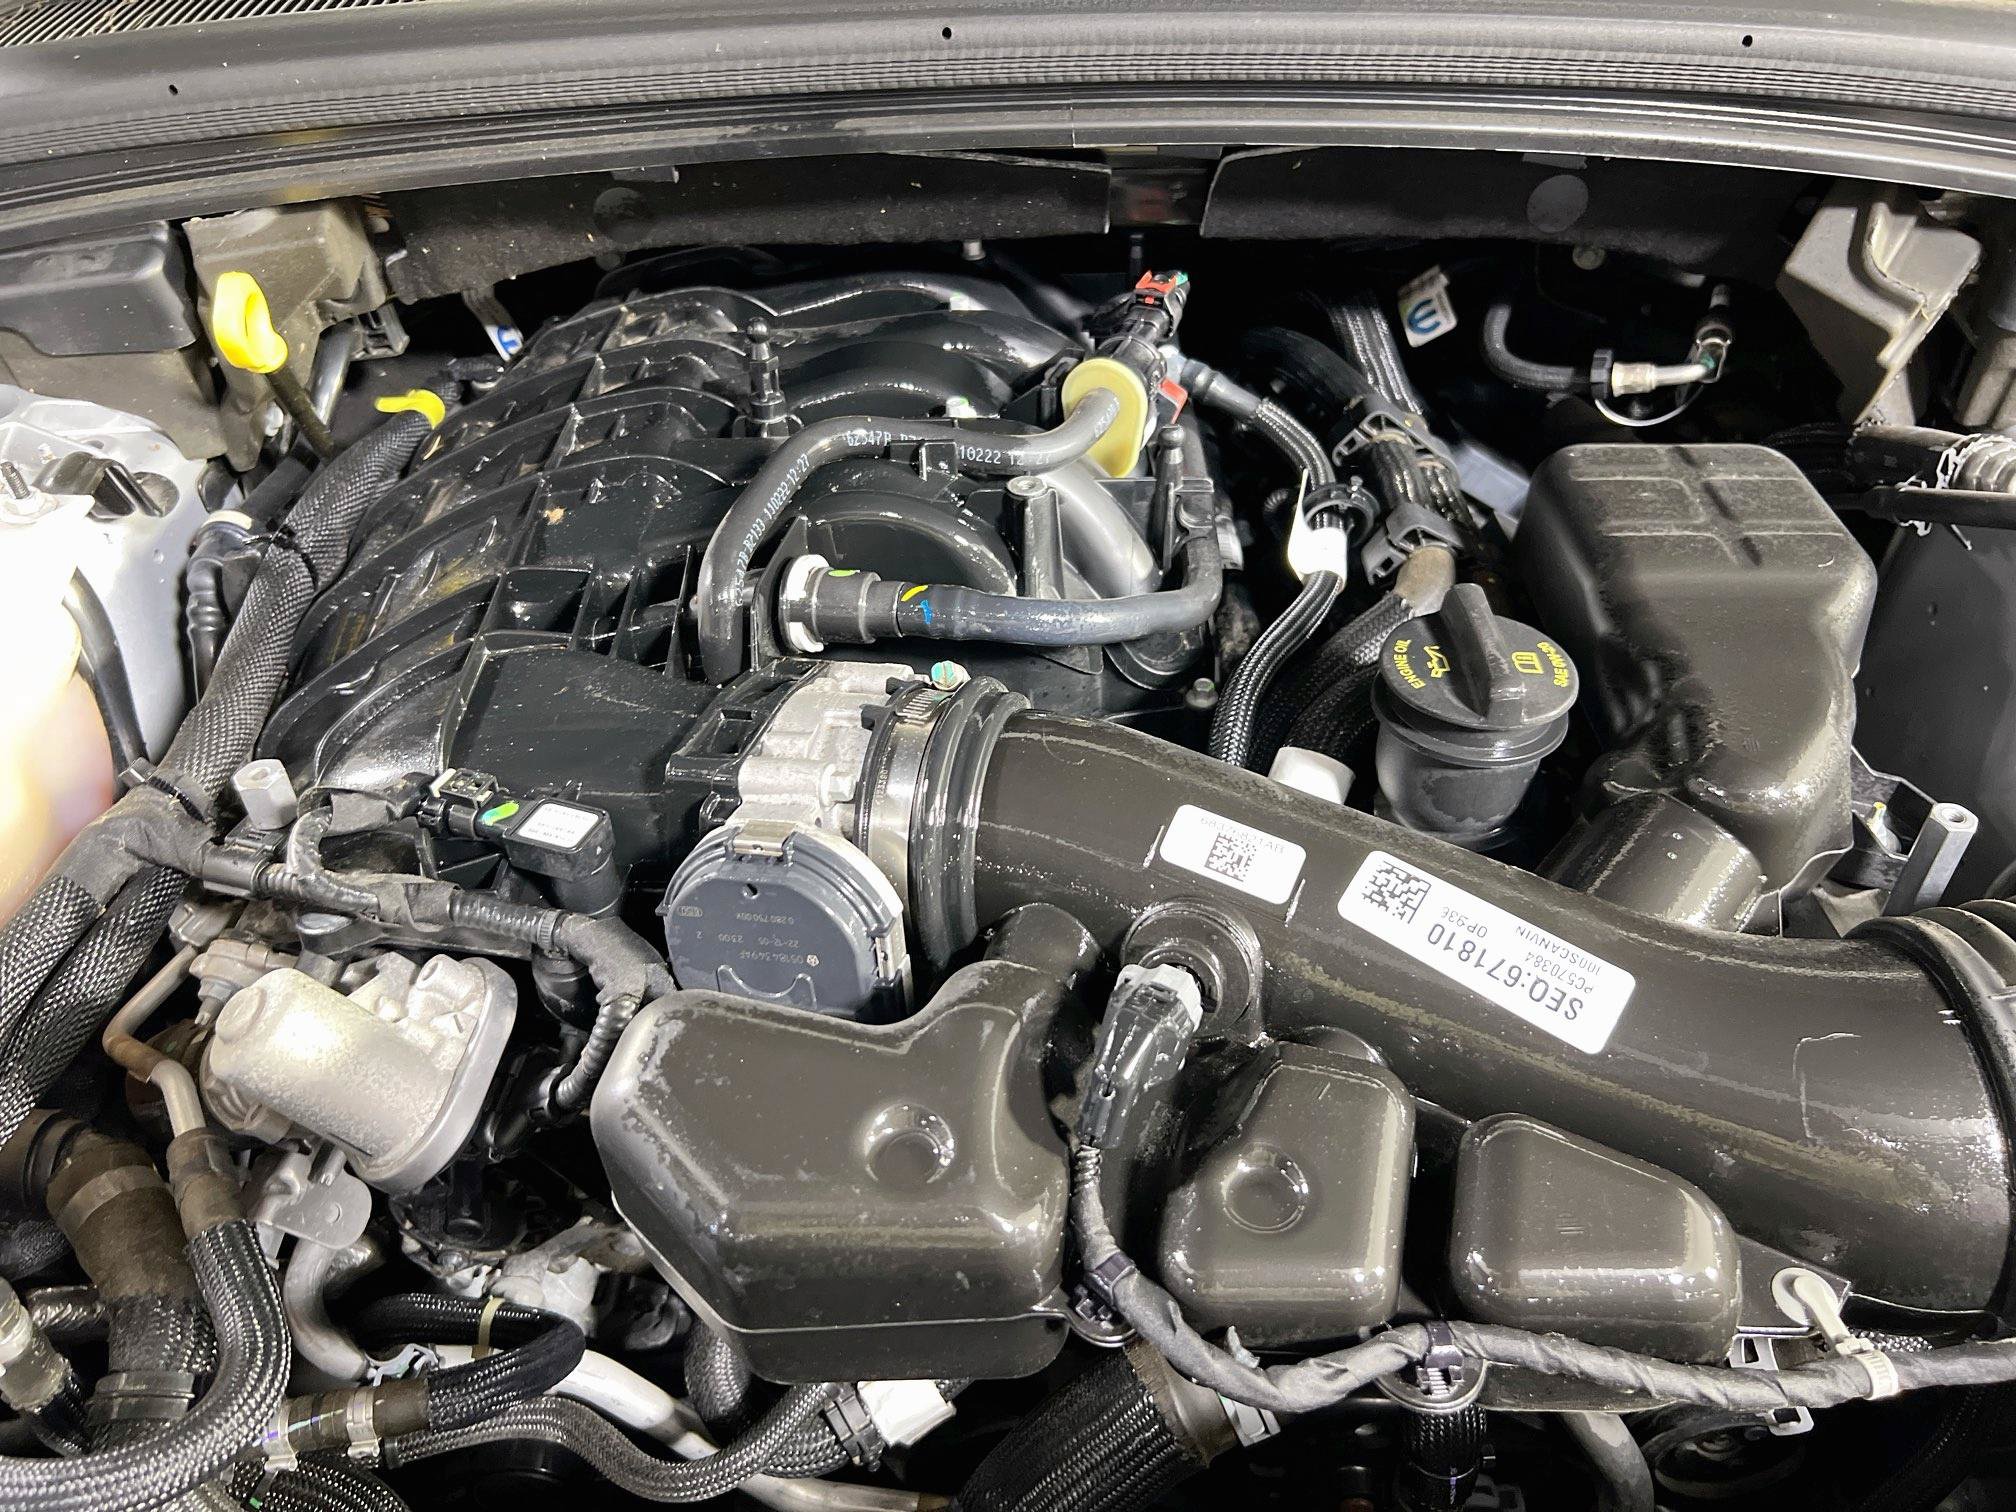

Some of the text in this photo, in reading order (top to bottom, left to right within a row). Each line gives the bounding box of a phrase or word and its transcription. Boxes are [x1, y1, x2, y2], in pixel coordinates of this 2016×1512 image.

[763, 481, 791, 520] 110222
[787, 453, 811, 486] 12:27
[1393, 638, 1426, 689] ENGINE OIL
[1553, 667, 1569, 688] SAE
[1427, 923, 1584, 1021] SEQ:671810
[1524, 951, 1594, 994] PC570384
